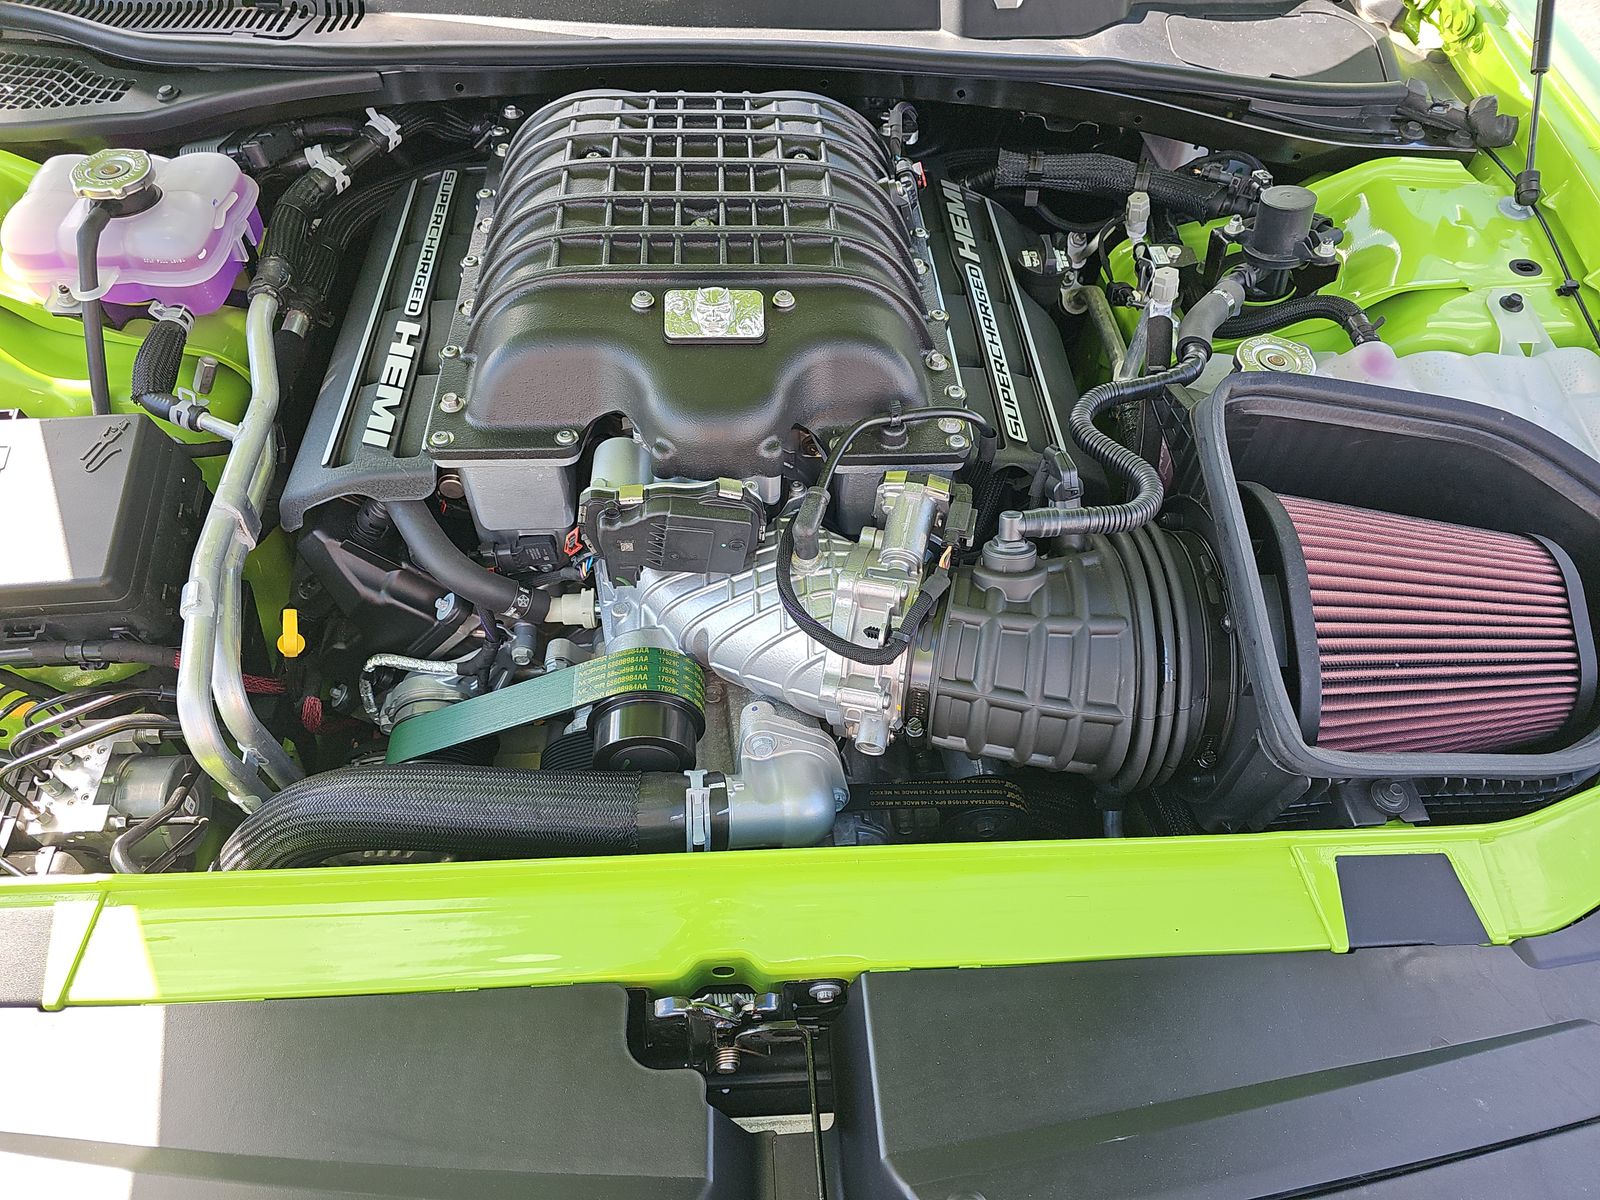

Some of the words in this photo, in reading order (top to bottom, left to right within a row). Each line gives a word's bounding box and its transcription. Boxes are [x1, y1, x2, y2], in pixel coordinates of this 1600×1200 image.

[406, 171, 456, 314] SUPERCHARGED
[940, 179, 981, 263] HEMI
[362, 320, 421, 447] HEMI
[967, 264, 1025, 439] SUPERCHARGED
